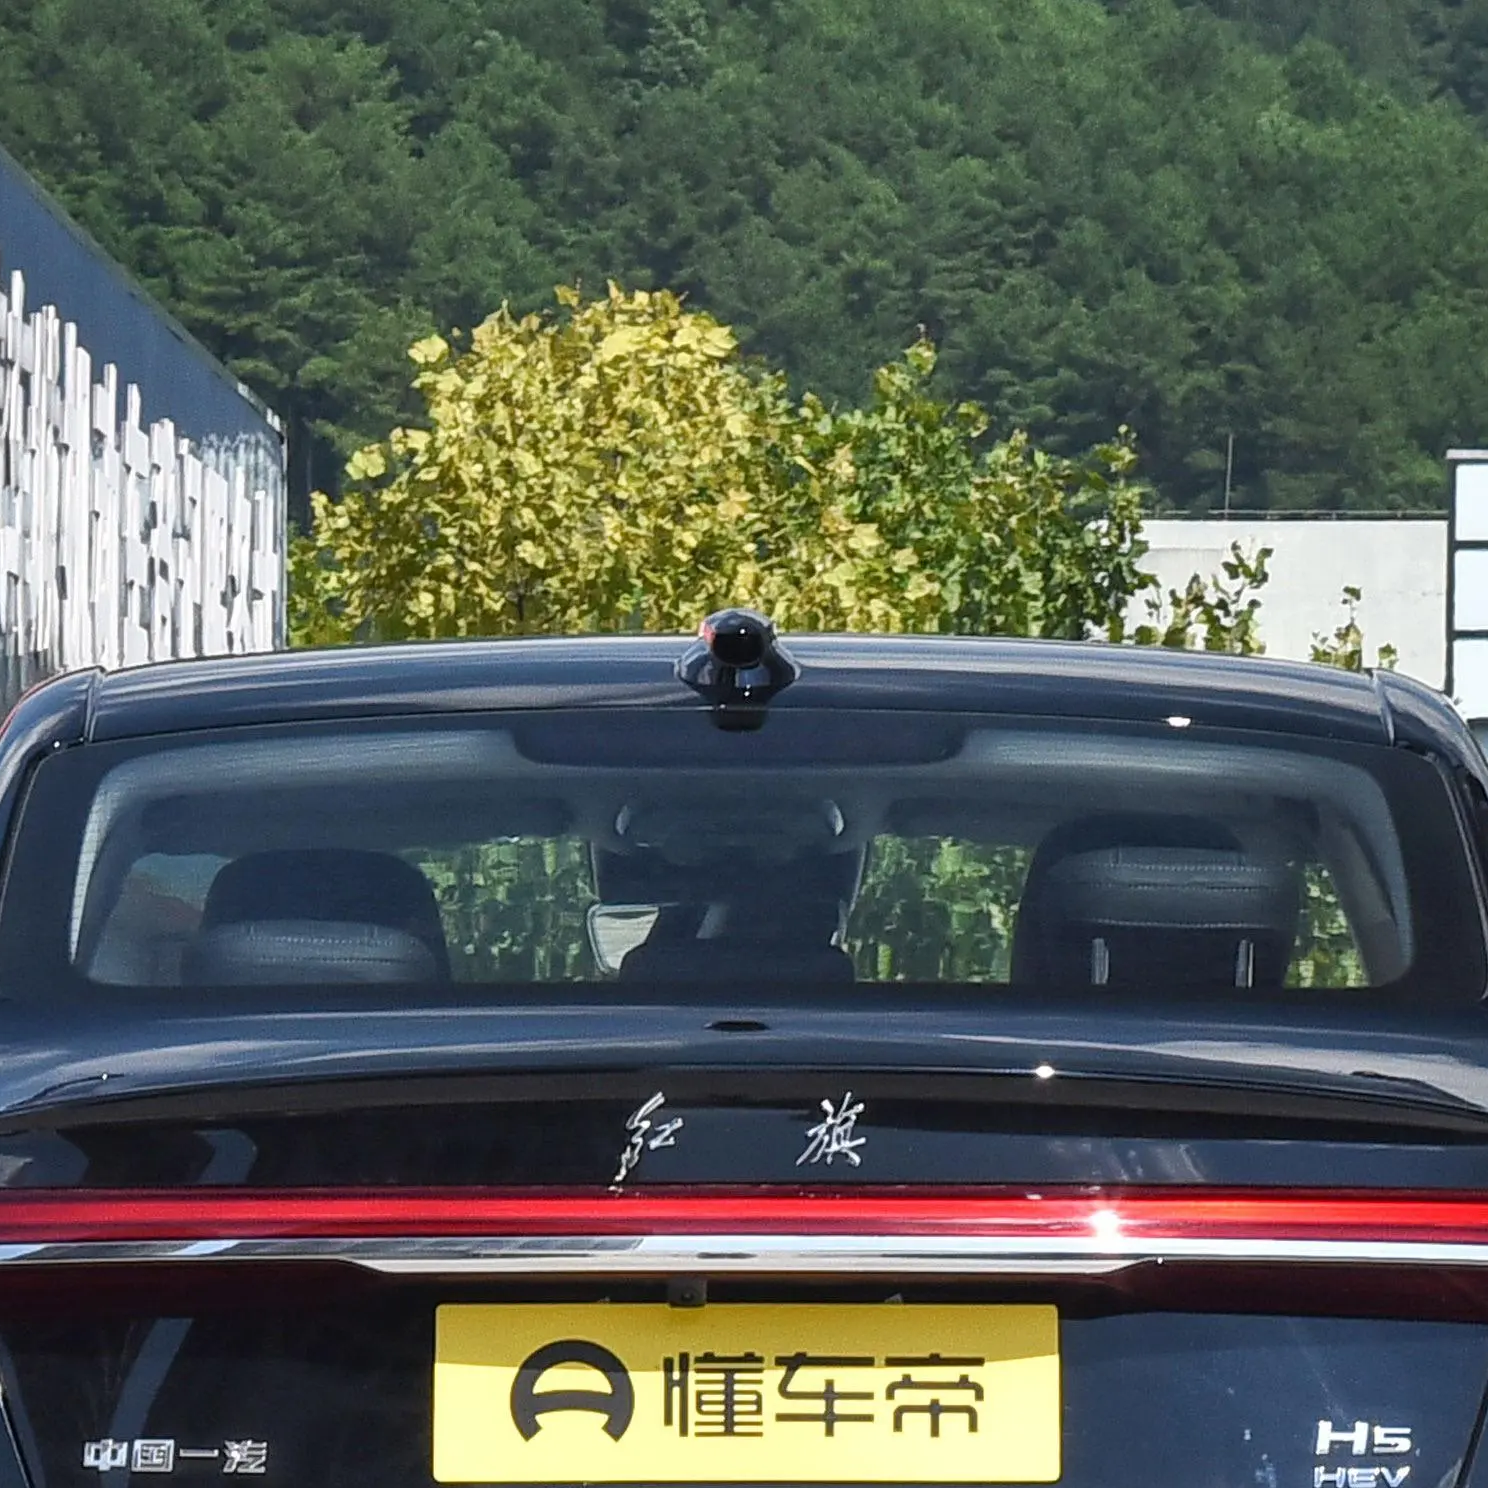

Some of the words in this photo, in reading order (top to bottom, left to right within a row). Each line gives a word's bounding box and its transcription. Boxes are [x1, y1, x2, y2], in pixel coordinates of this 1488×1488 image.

[613, 1091, 866, 1182] 红旗
[663, 1351, 986, 1438] 懂车帝
[83, 1438, 268, 1474] 中国一汽
[1315, 1420, 1412, 1456] H5
[1313, 1465, 1411, 1488] HEV
